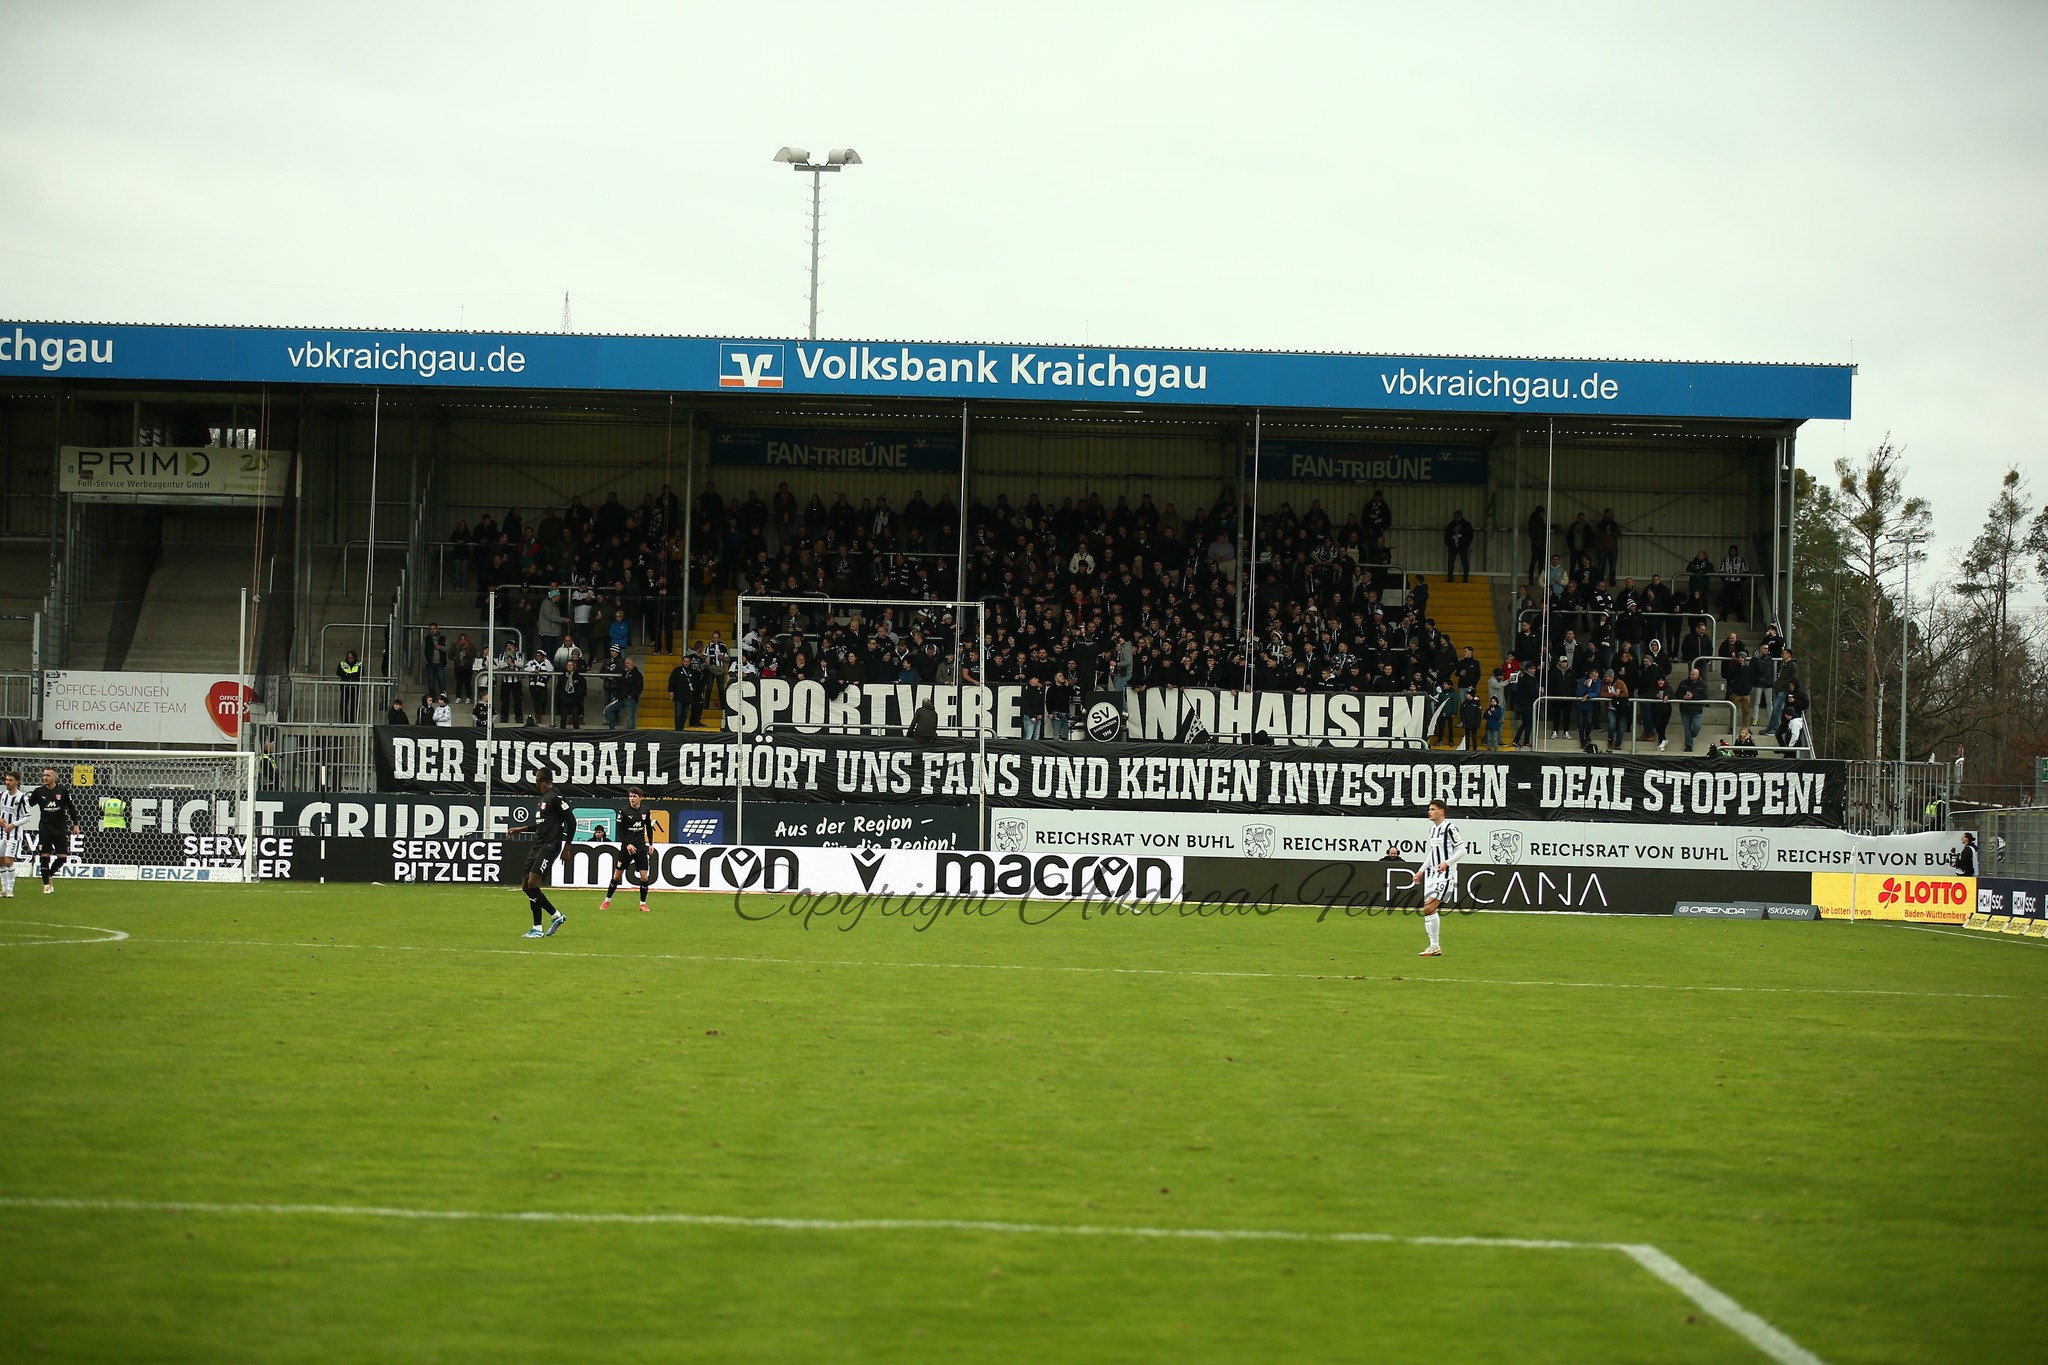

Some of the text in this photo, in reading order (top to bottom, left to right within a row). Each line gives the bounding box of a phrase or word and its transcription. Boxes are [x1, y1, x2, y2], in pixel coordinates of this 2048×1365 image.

[287, 340, 527, 378] vbkraichgau.de
[797, 346, 1208, 398] Volksbank Kraichgau
[1380, 367, 1619, 405] vbkraichgau.de
[766, 440, 908, 468] FAN-TRIBÜNE
[1290, 453, 1433, 481] FAN-TRIBÜNE
[77, 480, 211, 490] Full-Service Werbeagentur GmbH
[55, 682, 170, 698] OFFICE-LÖSUNGEN
[55, 697, 187, 715] FÜR DAS GANZE TEAM
[1091, 706, 1110, 724] SV
[54, 719, 123, 732] officemix.de
[392, 736, 465, 783] DER
[474, 739, 669, 786] FUSSBALL
[679, 734, 826, 791] GEHÖRT
[836, 749, 913, 795] UNS
[921, 751, 1022, 798] FANS
[1031, 755, 1110, 800] UND
[1118, 756, 1260, 803] KEINEN
[1268, 760, 1509, 808] INVESTOREN
[1539, 765, 1633, 811] DEAL
[1642, 768, 1826, 815] STOPPEN!
[774, 820, 808, 838] Aus
[815, 816, 846, 836] der
[853, 814, 913, 837] Region
[1034, 830, 1236, 850] REICHSRAT VON BUHL
[1282, 836, 1383, 853] REICHSRAT
[1387, 840, 1427, 854] VON
[392, 839, 503, 861] SERVICE
[1529, 842, 1729, 861] REICHSRAT VON BUHL
[1877, 852, 1918, 866] VON
[141, 867, 195, 880] BENZ
[393, 861, 501, 882] PITZLER
[935, 852, 1171, 898] macron
[1905, 880, 1968, 905] LOTTO
[1689, 906, 1746, 915] ORENDA
[1819, 906, 1872, 916] Die Lotterin von
[1904, 909, 1967, 921] Baden-Württemberg
